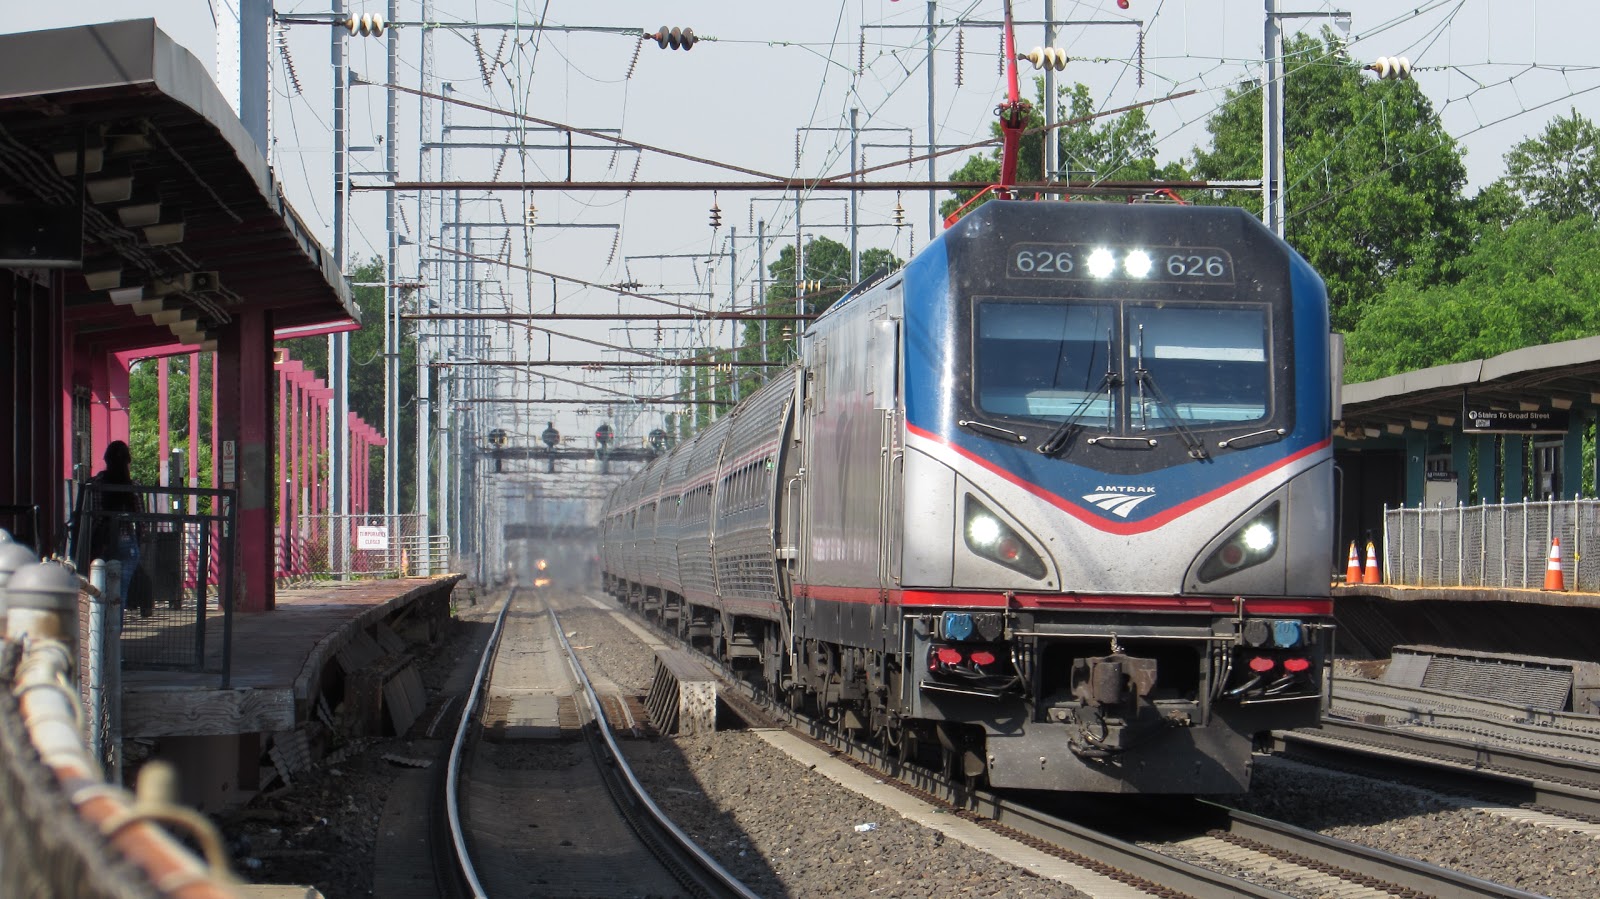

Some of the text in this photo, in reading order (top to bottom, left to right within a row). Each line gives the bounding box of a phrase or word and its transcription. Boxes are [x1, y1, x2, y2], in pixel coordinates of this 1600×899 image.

[1016, 251, 1074, 272] 626
[1166, 254, 1224, 277] 626
[1478, 411, 1497, 419] Stairs
[1500, 411, 1507, 419] To
[1095, 485, 1155, 493] AMTRAK
